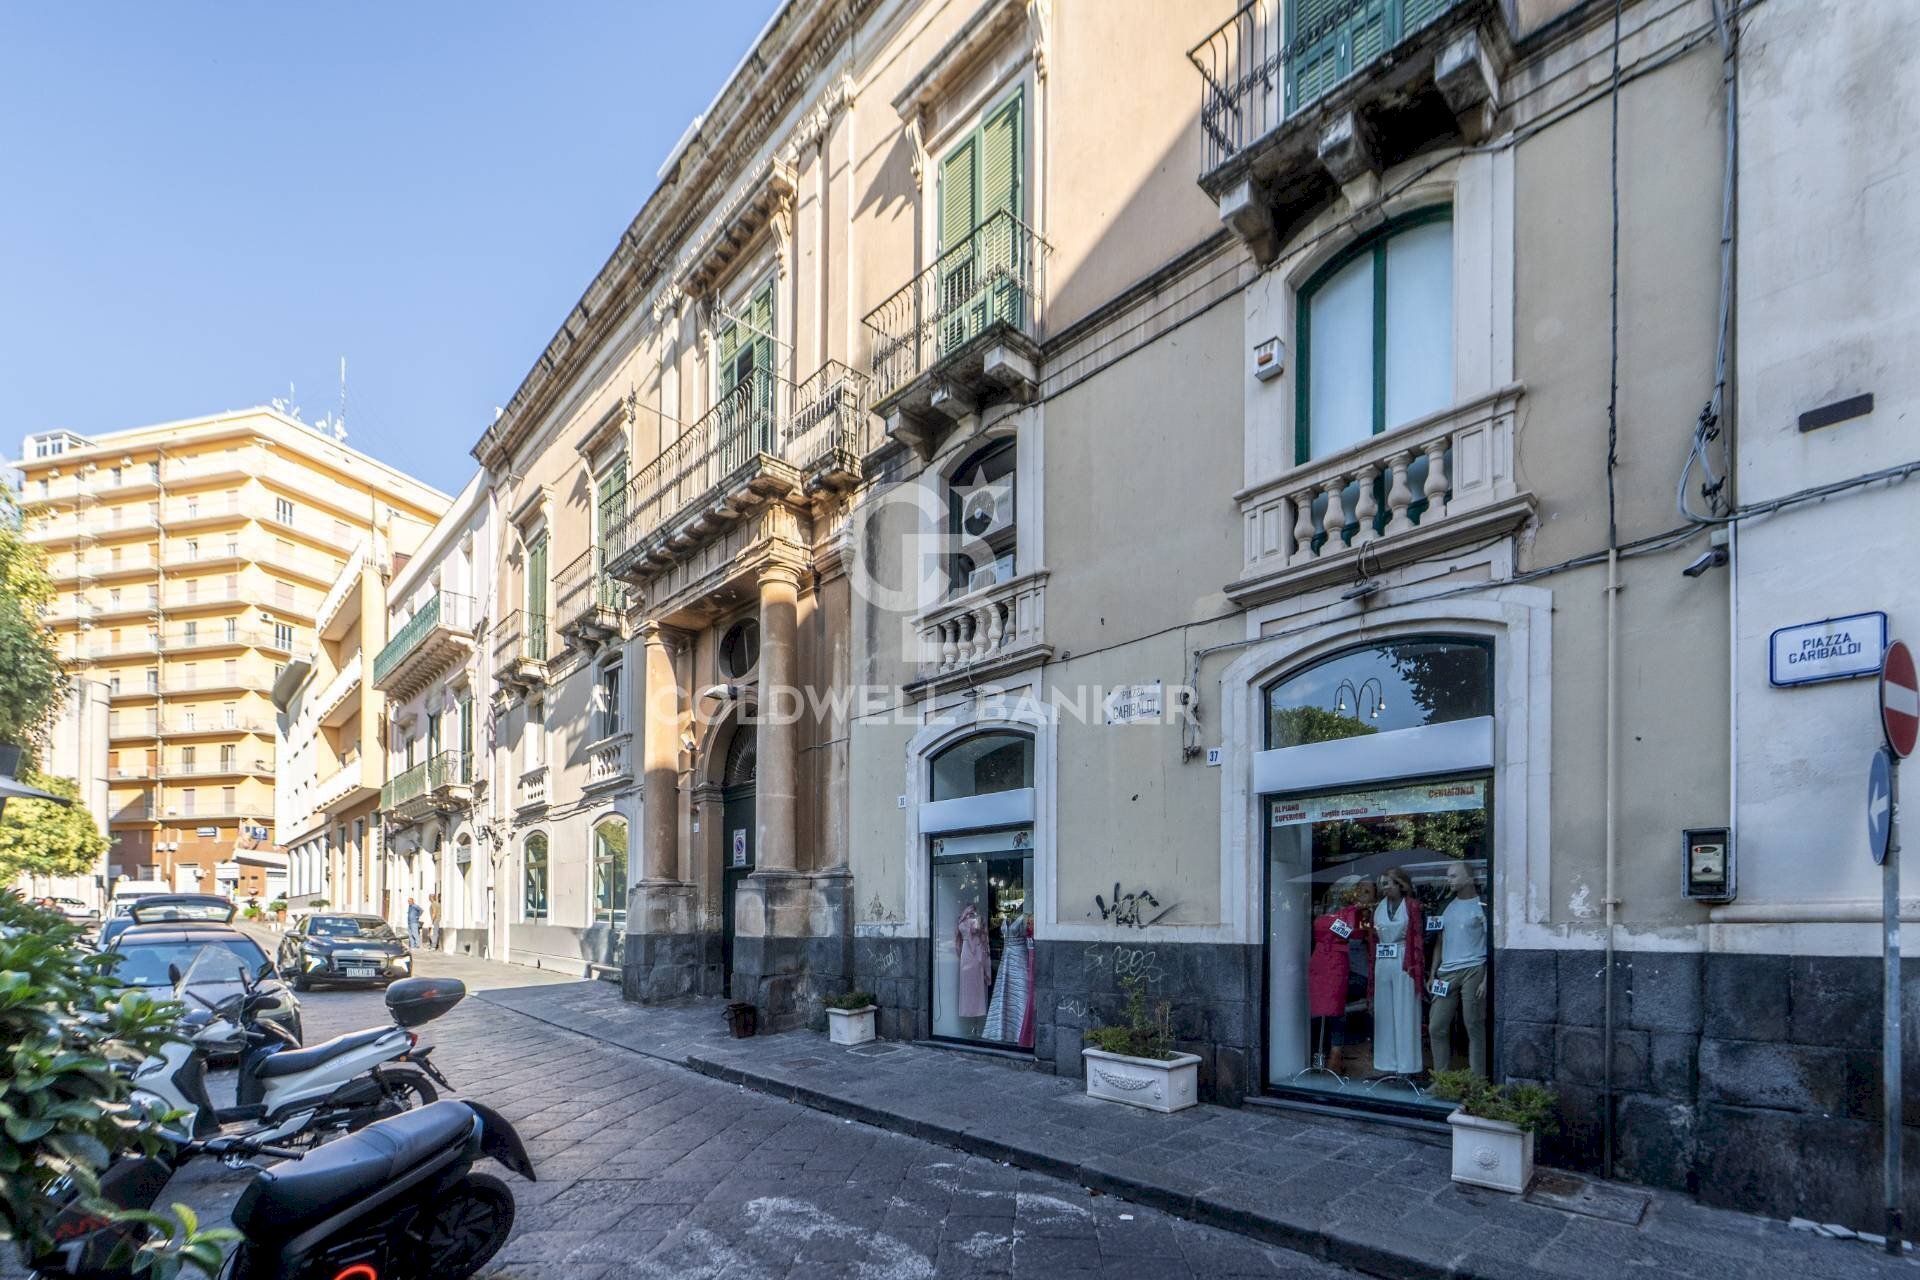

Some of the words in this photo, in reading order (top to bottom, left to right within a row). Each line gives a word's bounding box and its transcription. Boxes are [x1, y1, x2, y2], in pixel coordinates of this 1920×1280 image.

[1802, 632, 1852, 650] PIAZZA
[1788, 642, 1862, 664] GARIBALDI
[1121, 687, 1145, 700] PIAZZA
[1113, 699, 1156, 720] GARIBALDI
[1209, 750, 1219, 762] 37
